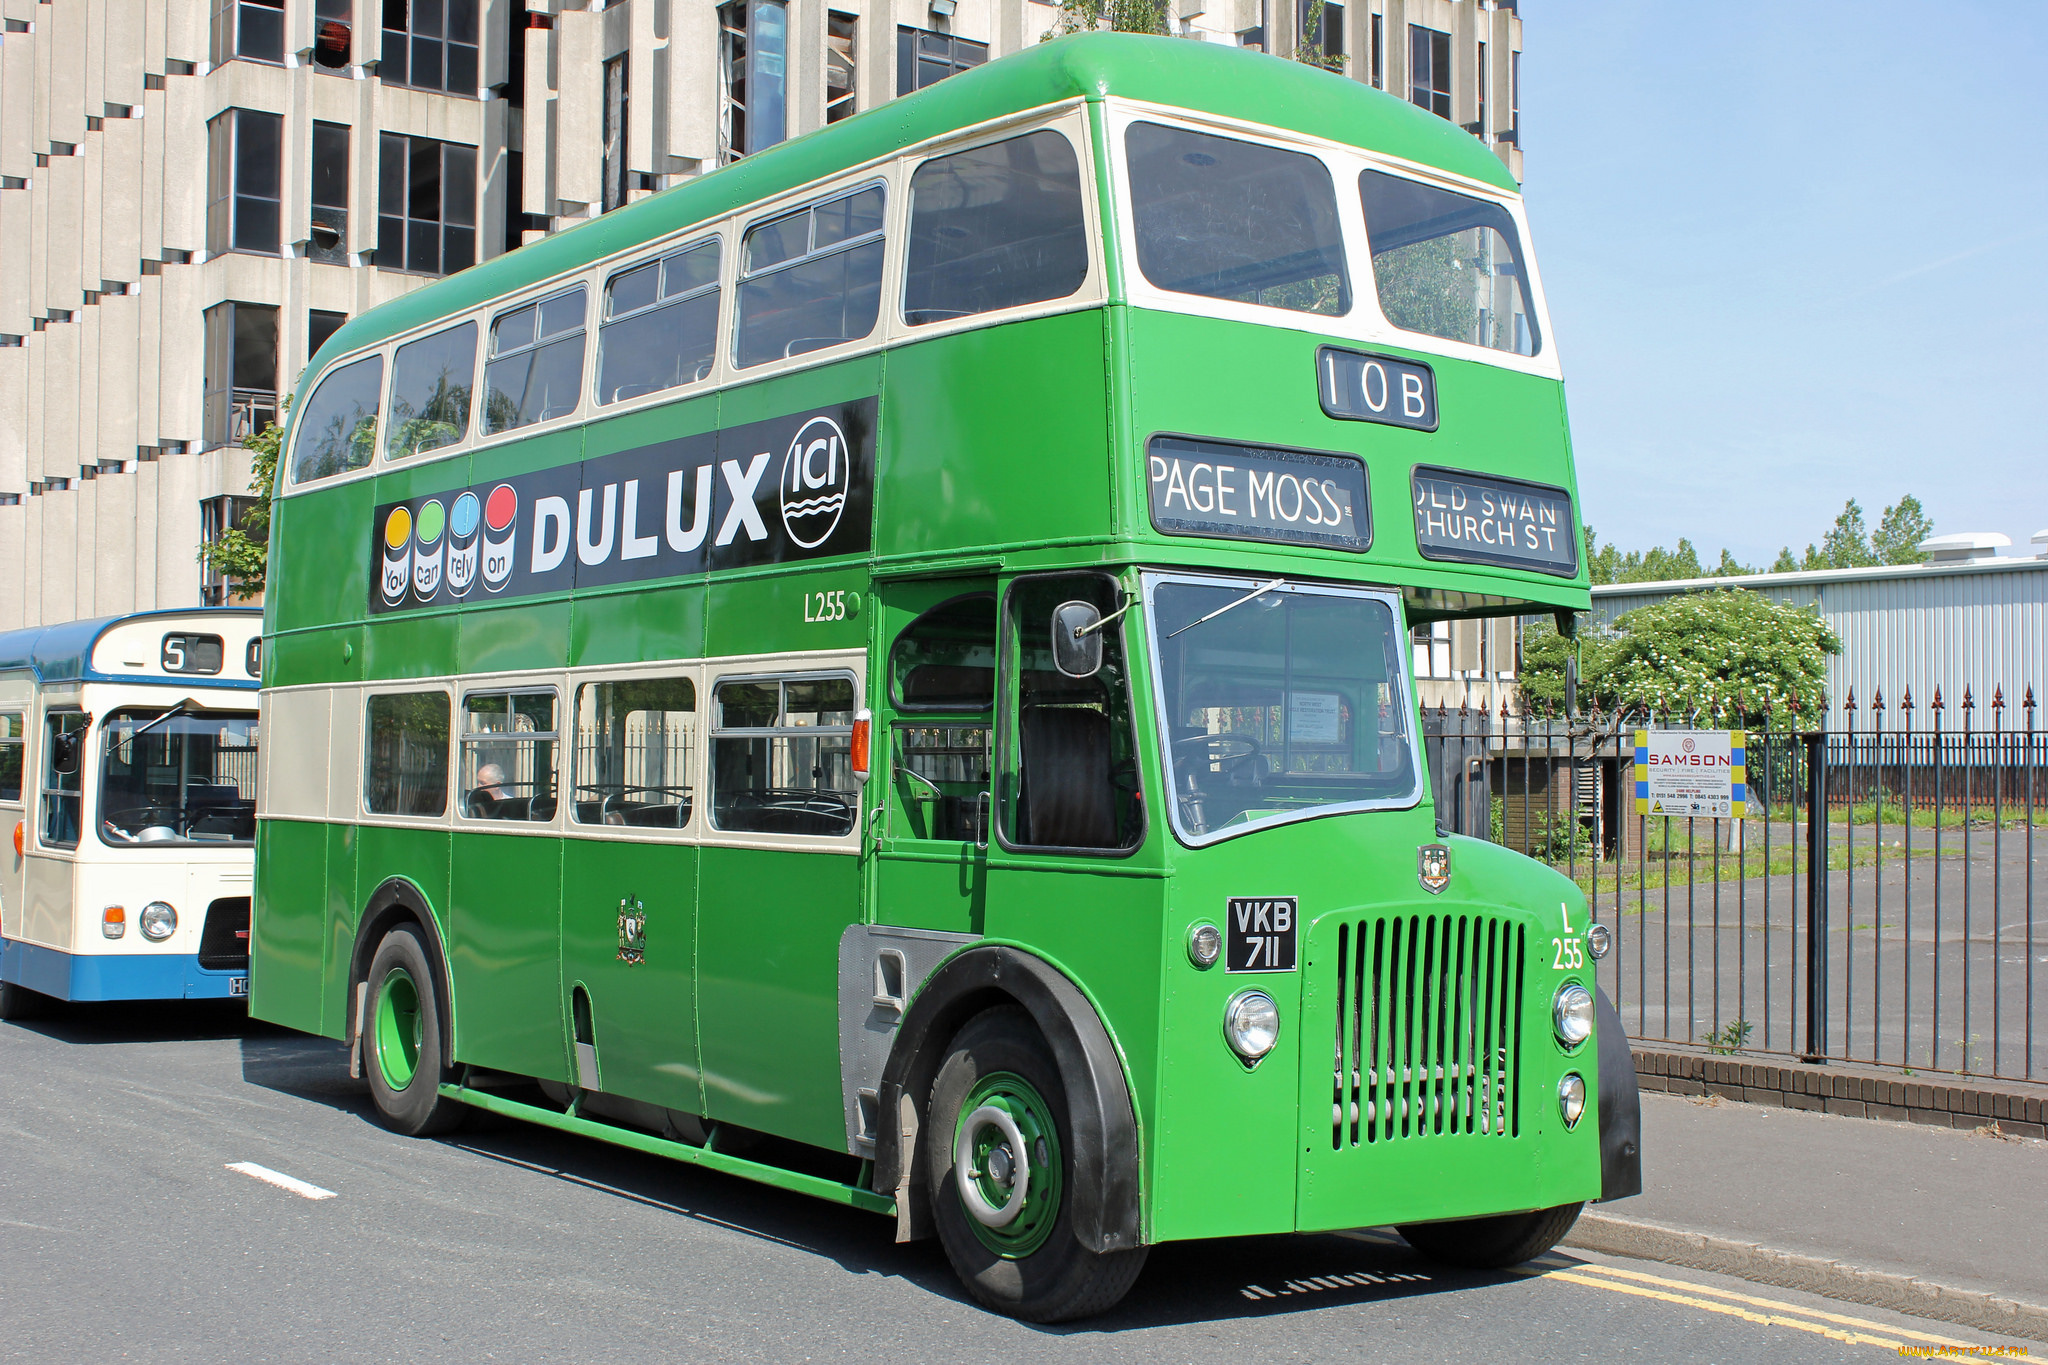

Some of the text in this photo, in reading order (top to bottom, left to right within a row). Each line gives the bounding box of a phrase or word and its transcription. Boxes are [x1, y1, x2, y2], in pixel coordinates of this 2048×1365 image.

[792, 435, 838, 493] ICI
[1150, 455, 1342, 527] PAGE MOSS
[530, 452, 771, 574] DULUX
[1481, 490, 1557, 526] SWAN
[1417, 508, 1557, 552] HURCH ST
[384, 553, 506, 591] You can rely on
[804, 590, 846, 623] L255
[163, 637, 186, 670] 5
[1649, 754, 1730, 766] SAMSON
[1234, 901, 1291, 933] VKB
[1560, 902, 1574, 933] L
[1245, 936, 1279, 968] 711
[1551, 937, 1584, 970] 255
